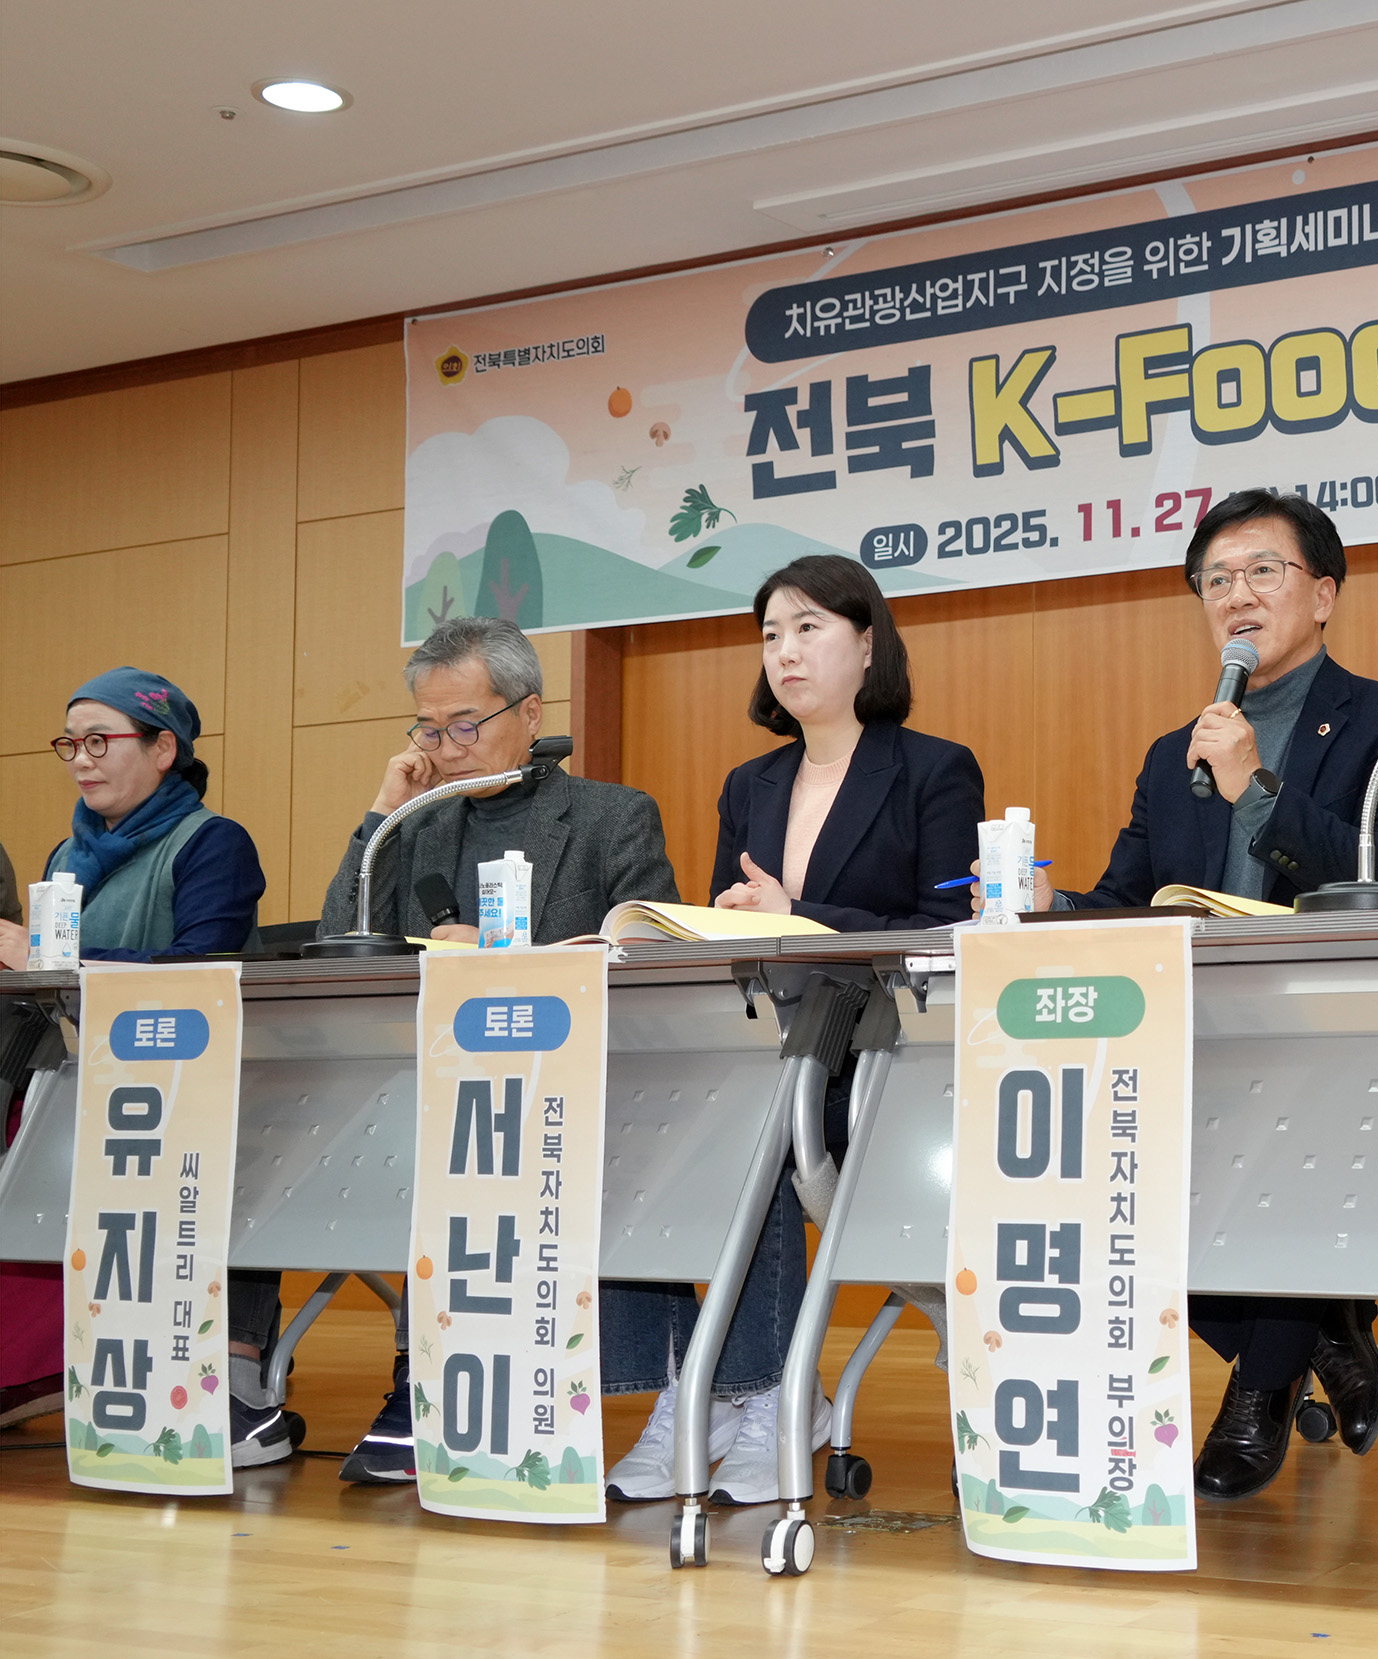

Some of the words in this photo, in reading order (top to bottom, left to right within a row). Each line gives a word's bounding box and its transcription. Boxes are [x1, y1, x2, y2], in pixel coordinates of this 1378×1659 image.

[784, 265, 1029, 340] 치유관광산업지구
[1037, 245, 1135, 298] 지정을
[1143, 233, 1209, 281] 위한
[473, 334, 606, 373] 전북특별자치도의회
[744, 364, 936, 500] 전북
[873, 530, 914, 560] 일시
[936, 508, 1060, 560] 2025.
[1078, 499, 1141, 542] 11.
[55, 929, 79, 941] WATER
[133, 1016, 177, 1048] 토론
[484, 1005, 534, 1039] 토론
[1034, 986, 1098, 1024] 좌장
[174, 1152, 201, 1282] 씨알트리
[534, 1096, 564, 1349] 전북자치도의회
[1106, 1068, 1140, 1352] 전북자치도의회
[90, 1085, 163, 1432] 유지상
[442, 1077, 523, 1456] 서난이
[994, 1066, 1086, 1494] 이명연
[170, 1300, 193, 1363] 대표
[531, 1367, 557, 1437] 의원
[1106, 1373, 1138, 1494] 부의장
